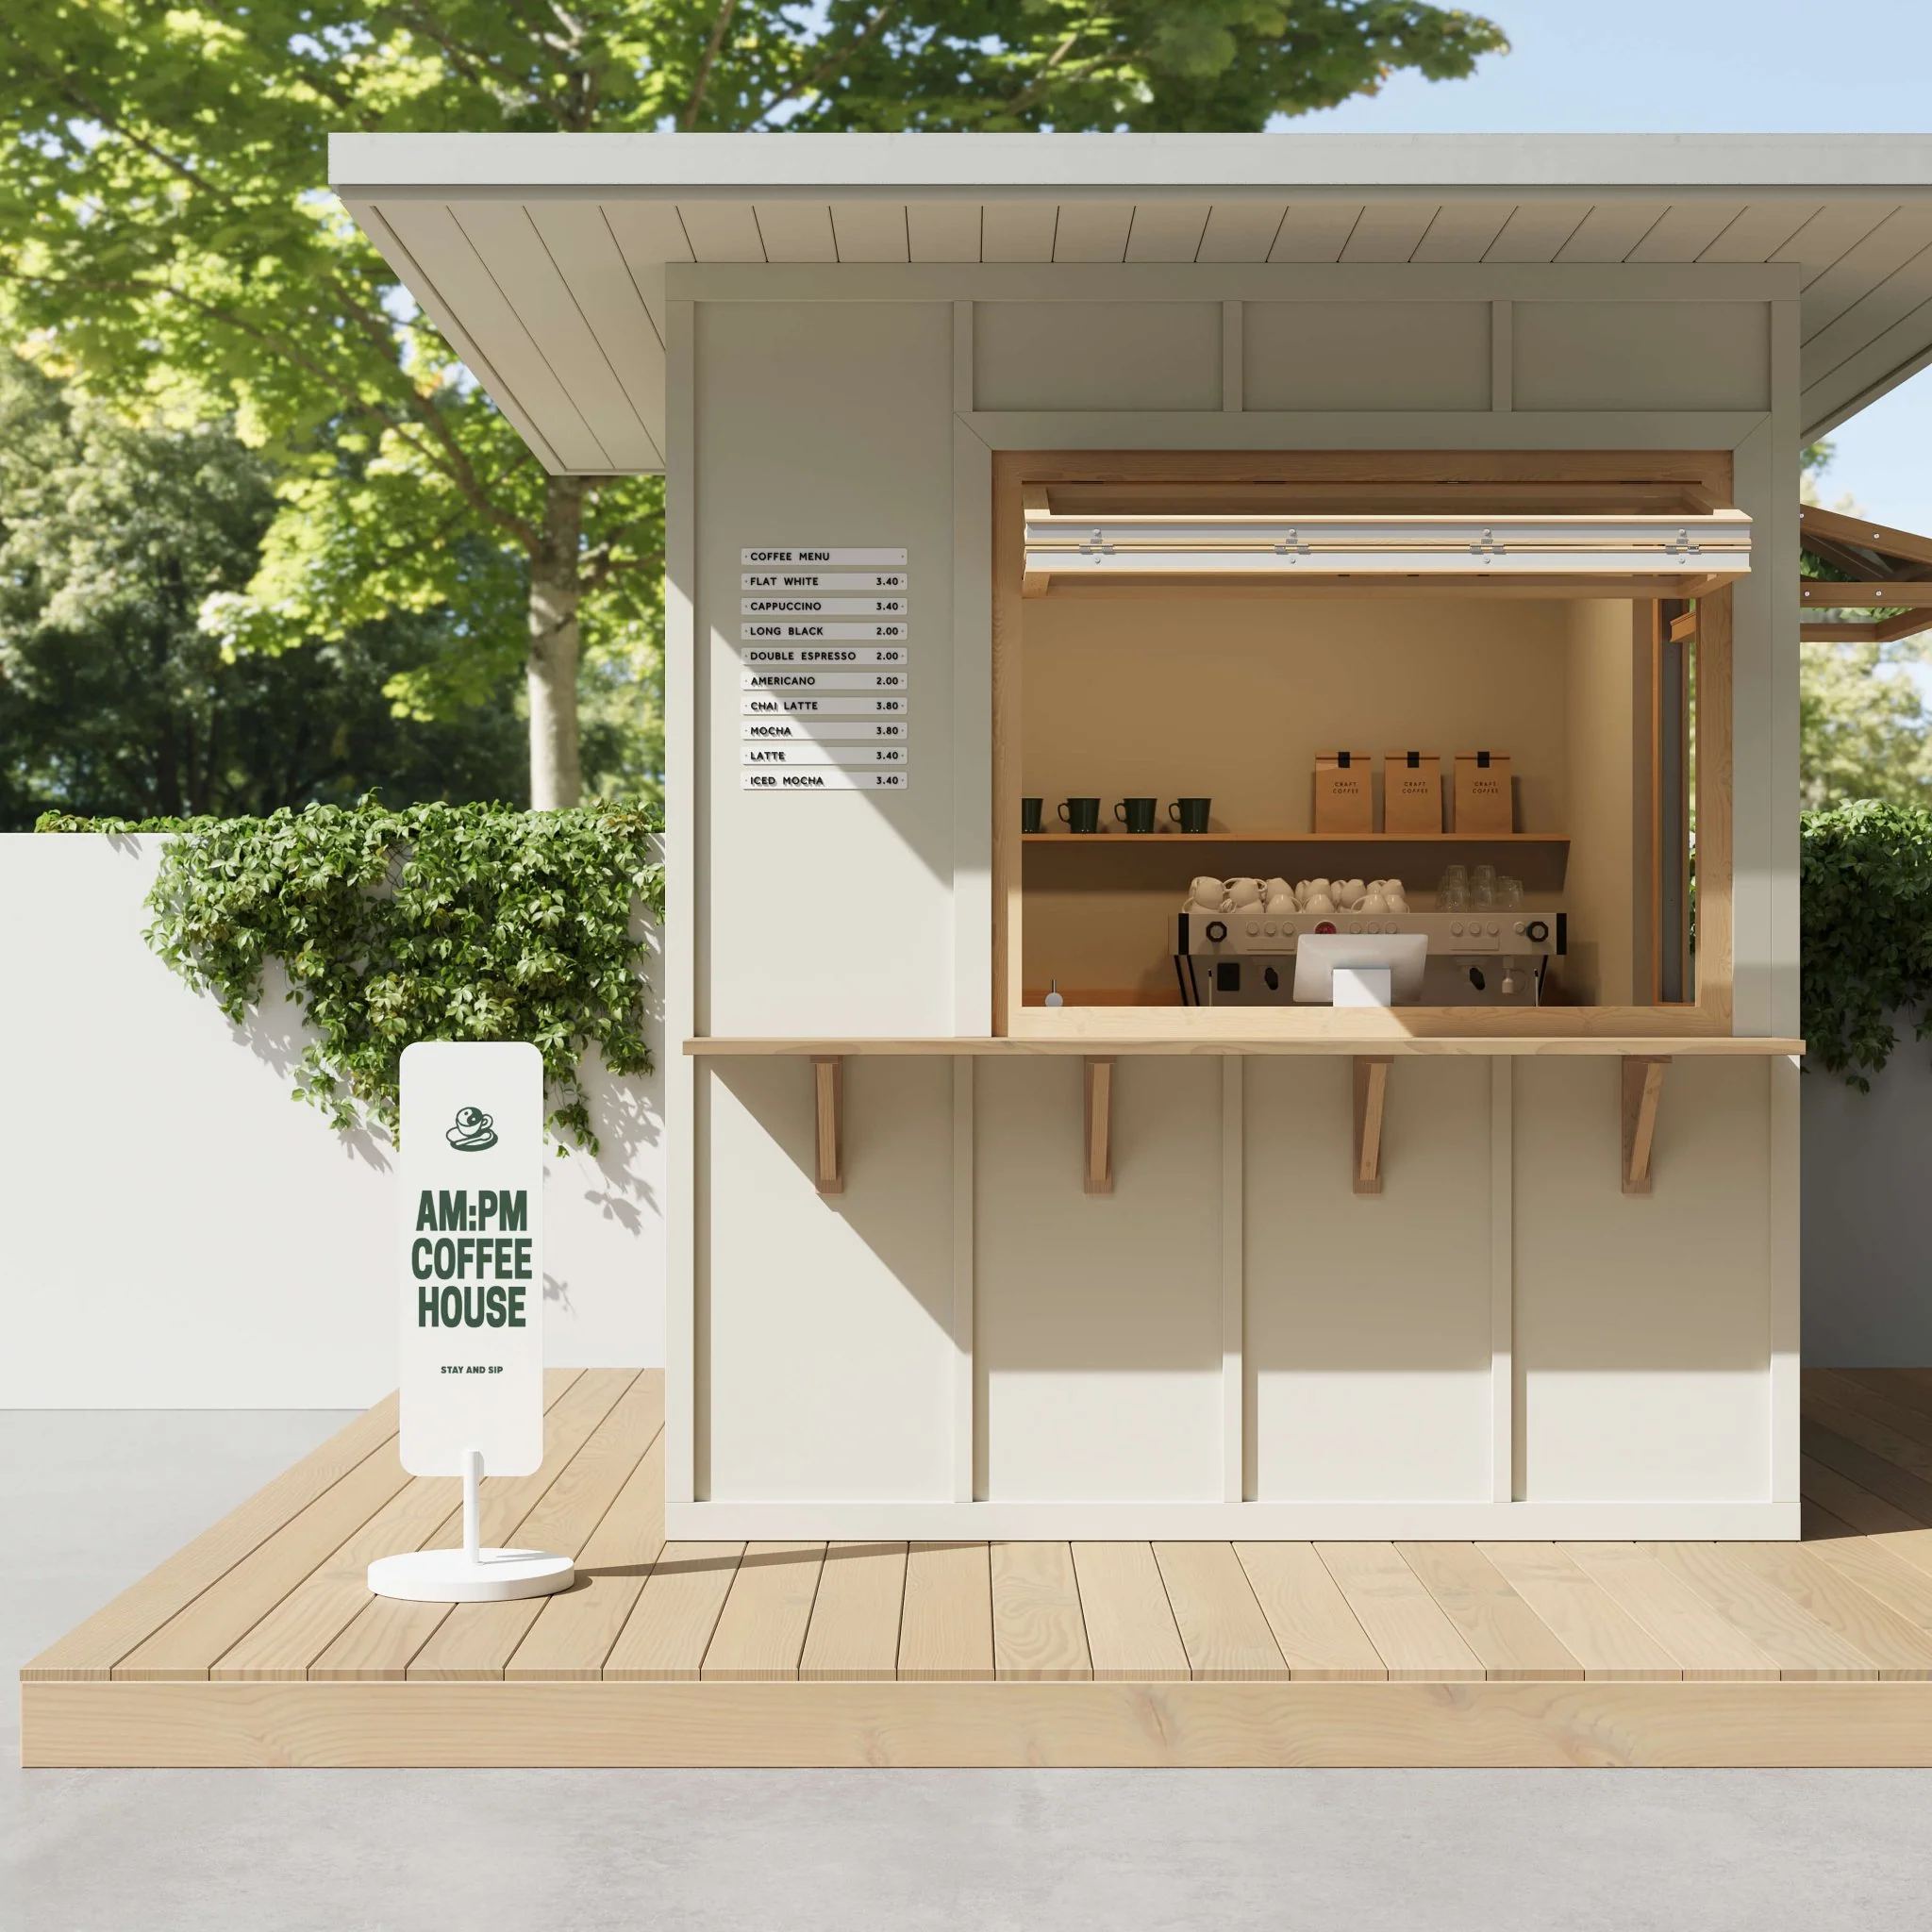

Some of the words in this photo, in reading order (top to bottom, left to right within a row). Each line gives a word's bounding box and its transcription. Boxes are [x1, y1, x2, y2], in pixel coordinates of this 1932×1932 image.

[750, 552, 792, 561] COFFEE
[798, 552, 830, 561] MENU
[750, 576, 777, 586] FLAT
[783, 576, 819, 586] WHITE
[875, 576, 899, 586] 3.40
[750, 602, 822, 611] CAPPUCCINO
[875, 602, 899, 611] 3.40
[750, 626, 781, 636] LONG
[788, 626, 824, 636] BLACK
[875, 626, 899, 636] 2.00
[750, 651, 794, 660] DOUBLE
[801, 651, 857, 660] ESPRESSO
[875, 651, 899, 660] 2.00
[750, 676, 816, 686] AMERICANO
[875, 676, 899, 686] 2.00
[750, 701, 777, 710] CHAI
[783, 701, 818, 710] LATTE
[875, 701, 899, 710] 3.80
[750, 726, 791, 736] MOCHA
[875, 726, 899, 736] 3.80
[750, 751, 785, 760] LATTE
[875, 751, 899, 760] 3.40
[750, 775, 776, 785] ICED
[782, 775, 824, 785] MOCHA
[875, 775, 899, 785] 3.40
[415, 1190, 527, 1232] AM:PM
[411, 1237, 533, 1280] COFFEE
[418, 1285, 526, 1328] HOUSE
[441, 1366, 464, 1374] STAY
[465, 1366, 486, 1374] AND
[488, 1366, 504, 1374] SIP
